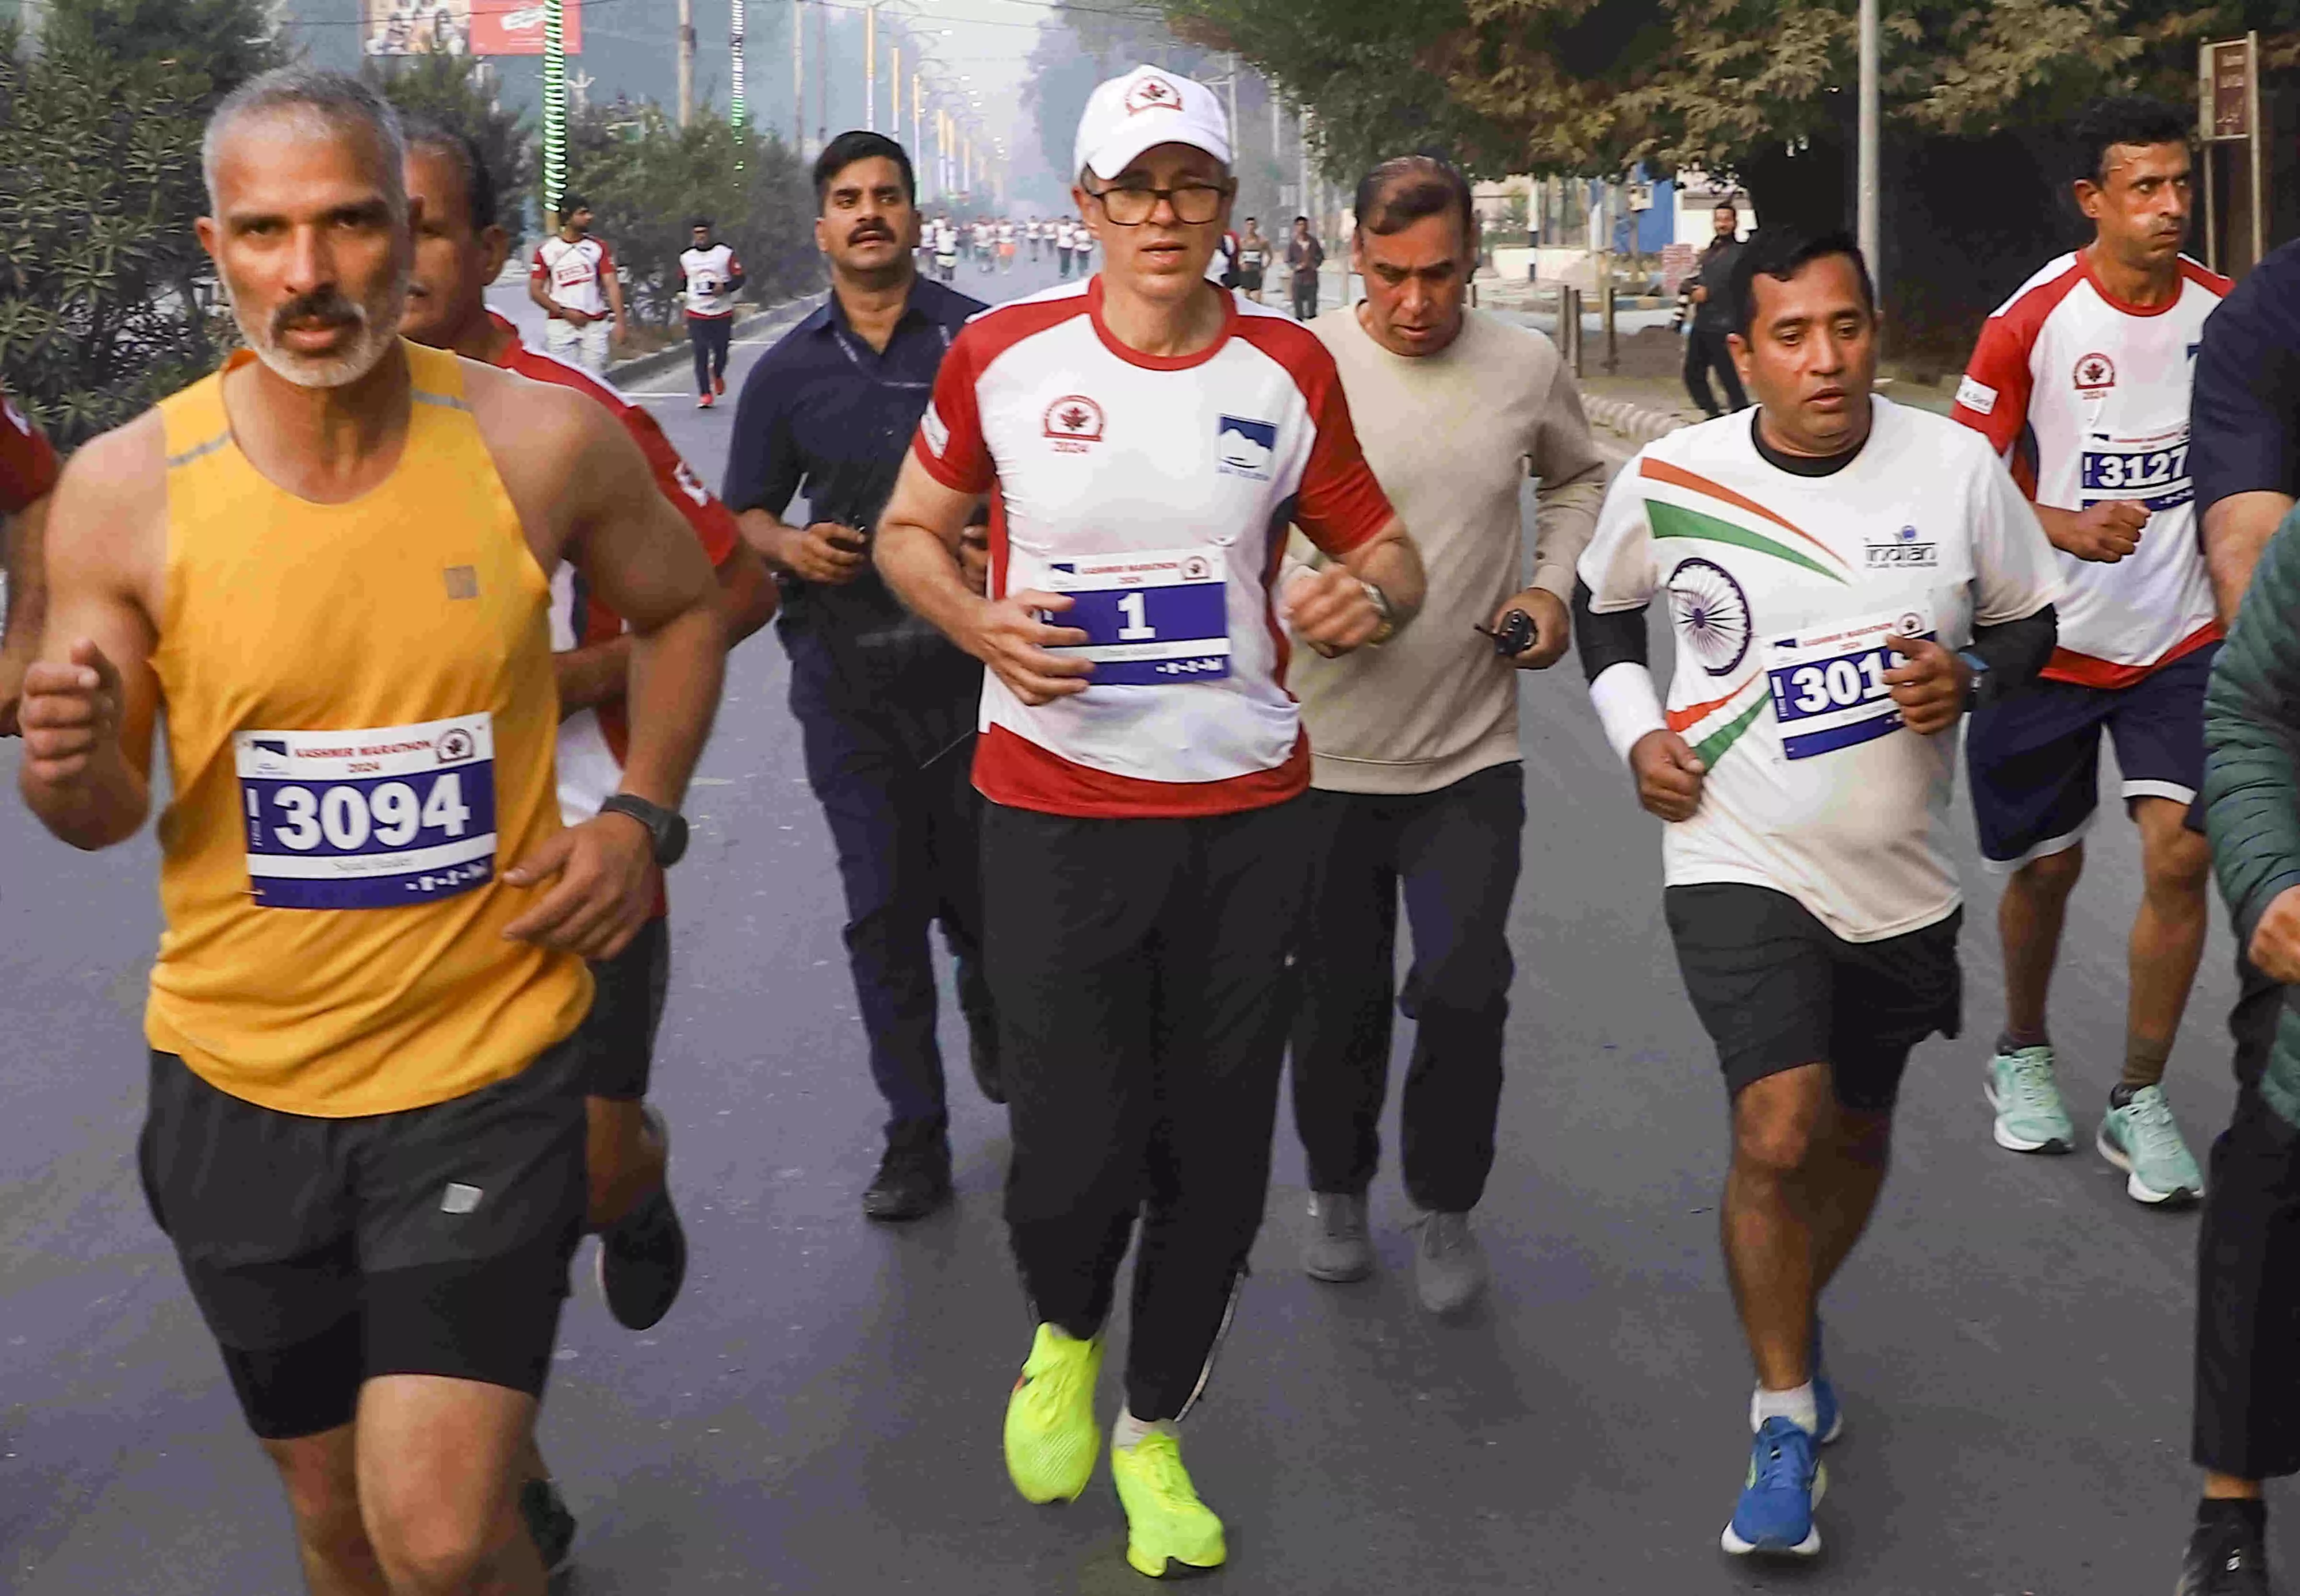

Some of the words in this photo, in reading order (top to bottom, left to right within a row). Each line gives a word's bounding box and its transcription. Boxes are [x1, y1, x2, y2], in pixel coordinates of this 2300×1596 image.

[2097, 445, 2189, 487] 3127
[1117, 592, 1156, 640] 1
[347, 762, 380, 773] 2024
[360, 740, 431, 756] MARATHON
[273, 772, 471, 850] 3094
